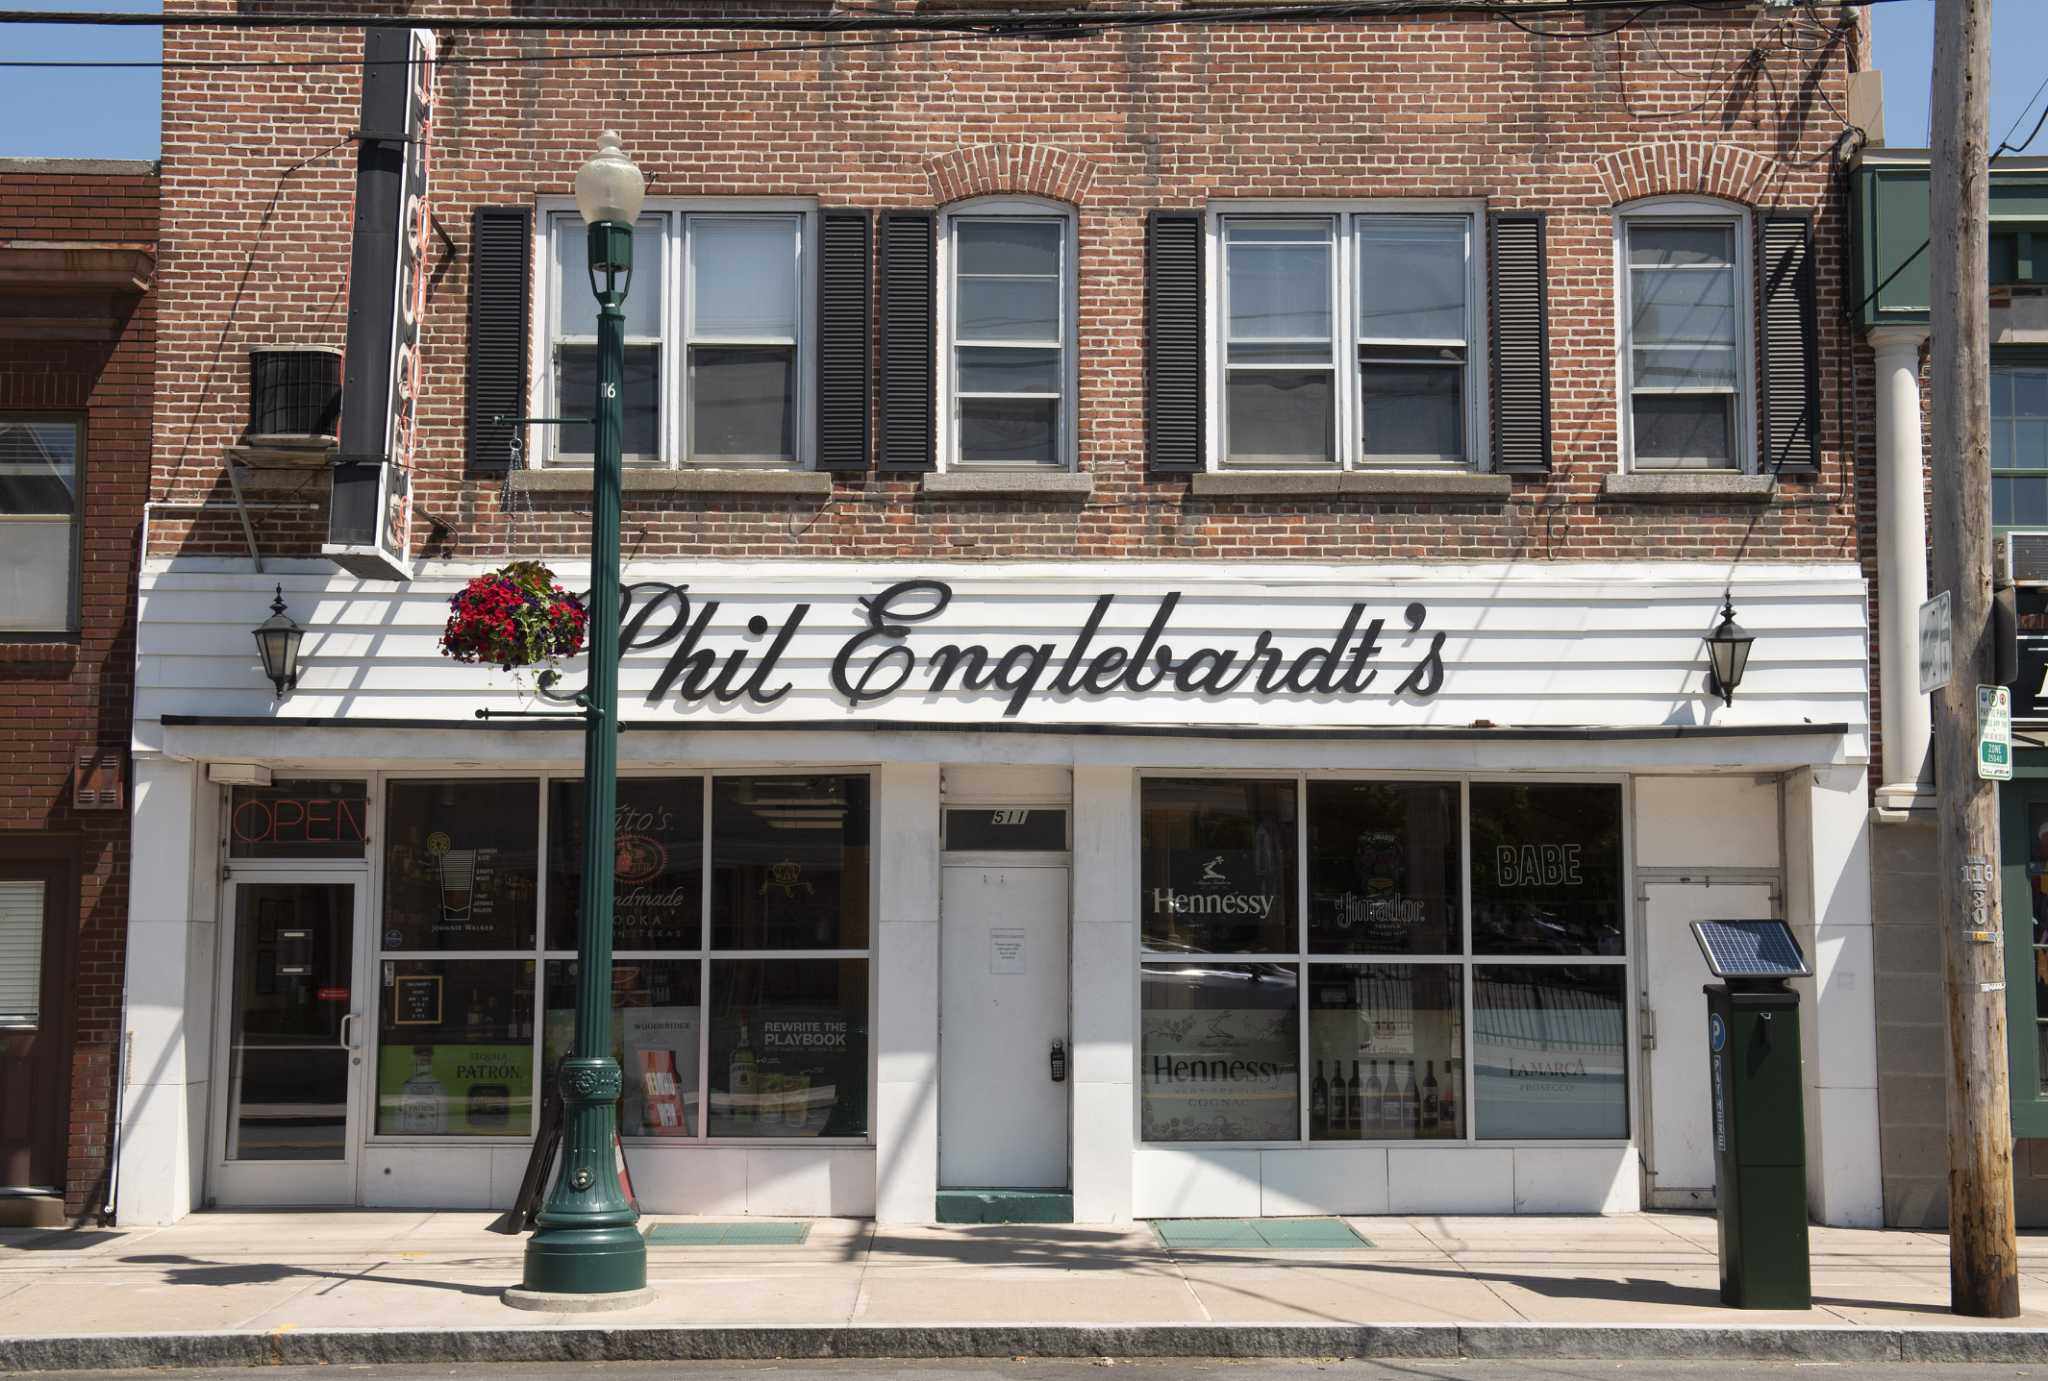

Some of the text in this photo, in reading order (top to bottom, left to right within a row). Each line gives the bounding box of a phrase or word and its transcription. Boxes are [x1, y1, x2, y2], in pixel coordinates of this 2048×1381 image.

[538, 581, 811, 705] Phil
[233, 799, 368, 842] OPEN
[1497, 843, 1584, 887] BABE
[1153, 887, 1274, 919] Hennessy
[764, 1022, 847, 1033] REWRITE THE
[764, 1033, 847, 1047] PLAYBOOK
